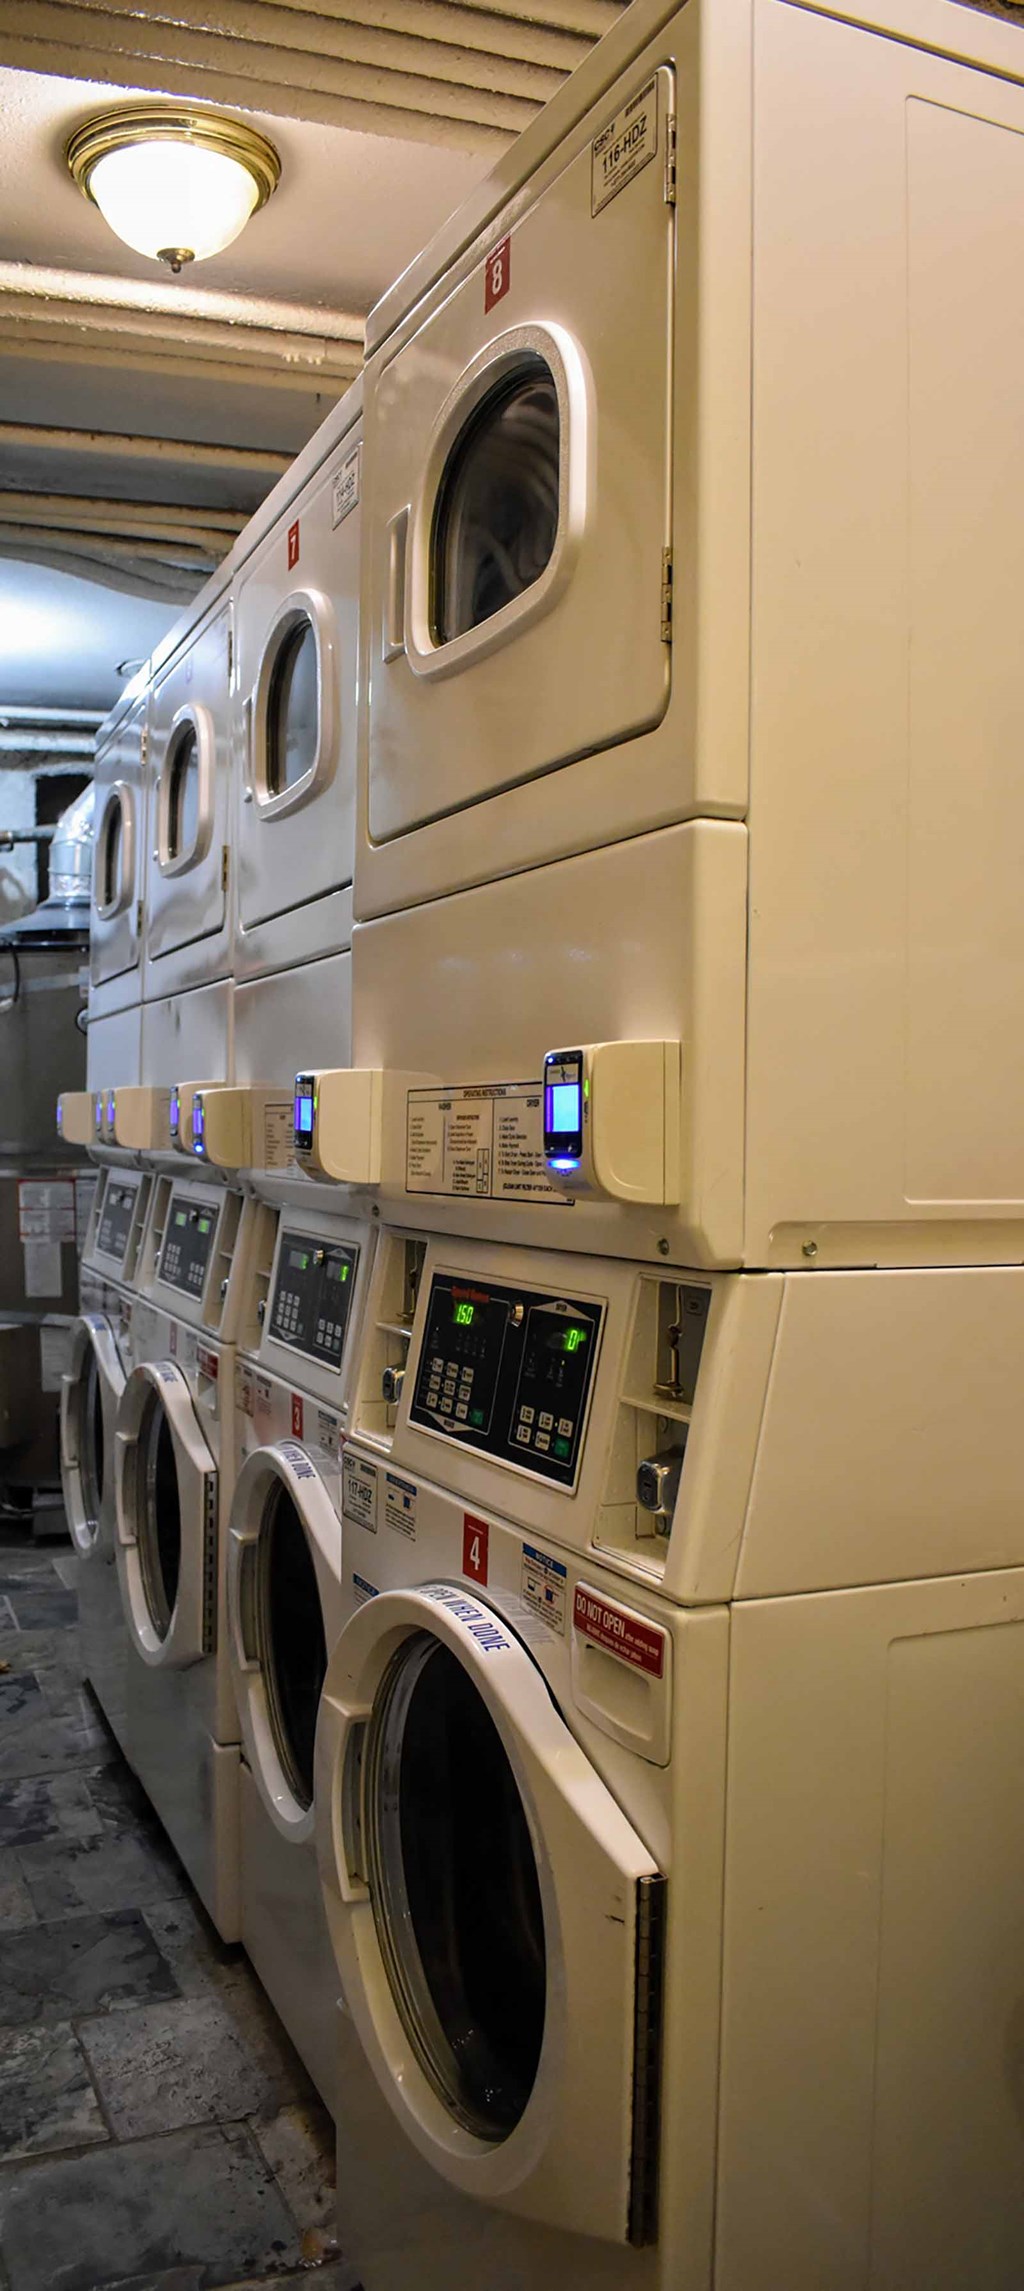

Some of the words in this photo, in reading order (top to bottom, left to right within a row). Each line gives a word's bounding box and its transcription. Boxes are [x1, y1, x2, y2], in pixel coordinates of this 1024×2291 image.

[602, 115, 647, 173] 116-HDZ
[492, 259, 503, 295] 8
[294, 1407, 300, 1431] 3
[469, 1536, 481, 1571] 4
[442, 1598, 486, 1622] WHEN
[467, 1623, 511, 1652] DONE
[576, 1594, 587, 1614] DO
[587, 1600, 603, 1623] NOT
[603, 1611, 625, 1638] OPEN
